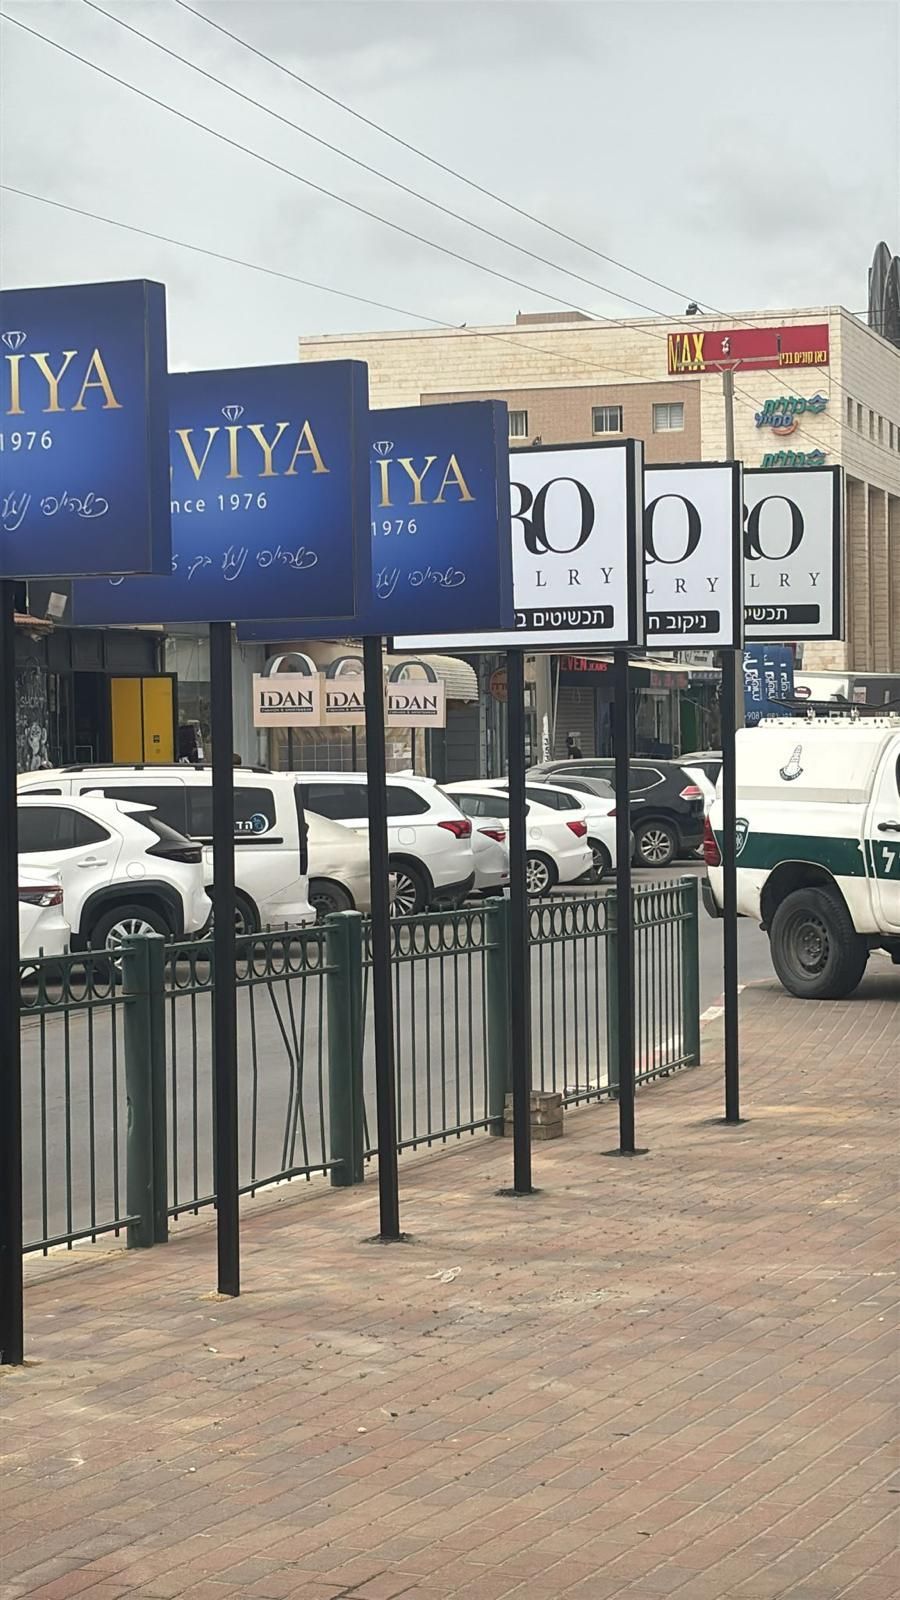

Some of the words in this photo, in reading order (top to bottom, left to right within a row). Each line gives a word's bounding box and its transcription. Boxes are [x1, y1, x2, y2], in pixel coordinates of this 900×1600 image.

[668, 334, 705, 371] MAX
[764, 396, 807, 416] כללית
[755, 412, 794, 428] סמייל
[0, 430, 53, 451] 1976
[170, 419, 331, 482] VIYA
[760, 450, 806, 468] כללית
[218, 492, 268, 511] 1976
[371, 519, 417, 536] 1976
[644, 494, 702, 565] O
[533, 609, 605, 626] תכשיטים
[744, 607, 788, 620] תכשי
[666, 615, 707, 633] ניקוב
[260, 690, 313, 707] IDAN
[326, 691, 365, 707] IDA
[388, 695, 437, 709] IDAN
